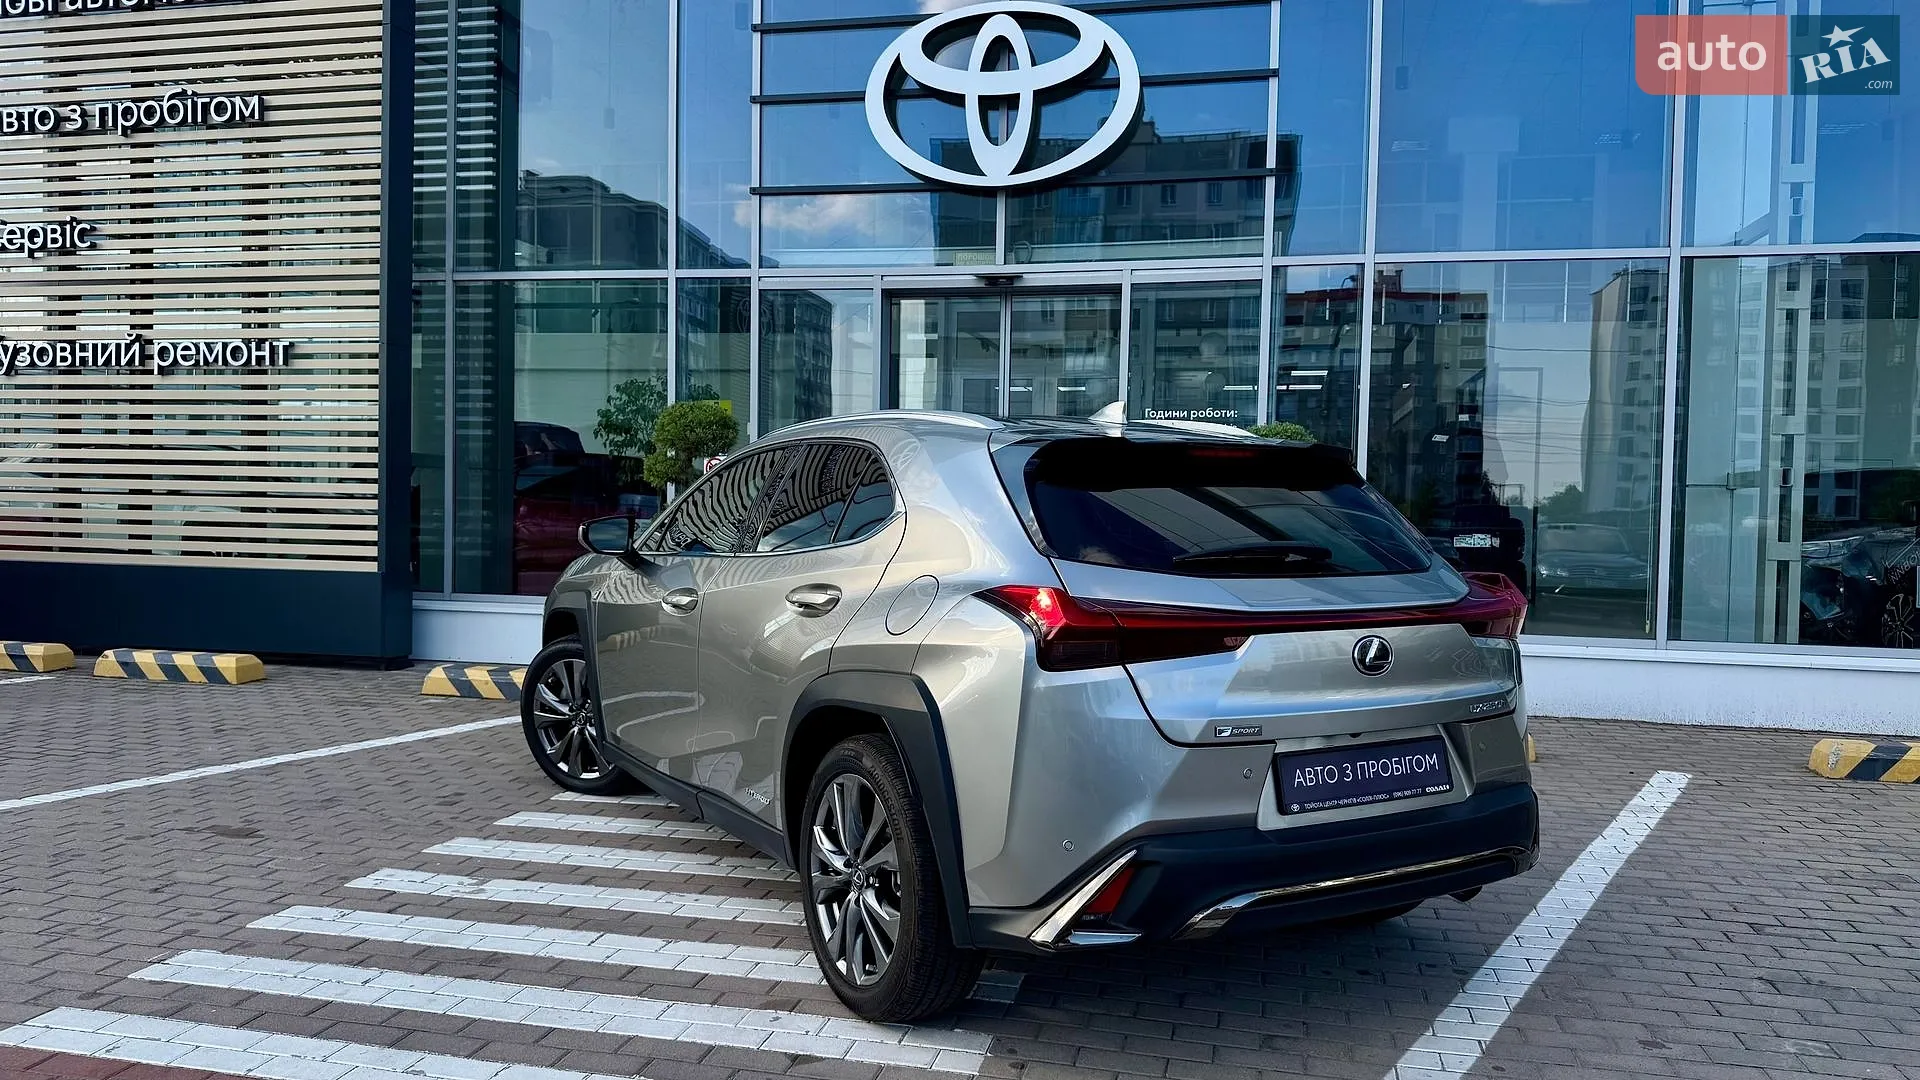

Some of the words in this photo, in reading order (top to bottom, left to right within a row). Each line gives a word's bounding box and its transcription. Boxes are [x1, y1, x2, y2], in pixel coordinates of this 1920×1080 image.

[95, 87, 260, 136] пробігом
[0, 215, 92, 258] ервіс
[153, 340, 290, 376] ремонт
[1145, 408, 1188, 419] Години
[1190, 407, 1239, 420] роботи:
[1294, 765, 1339, 788] АВТО
[1356, 752, 1439, 780] ПРОБІГОМ
